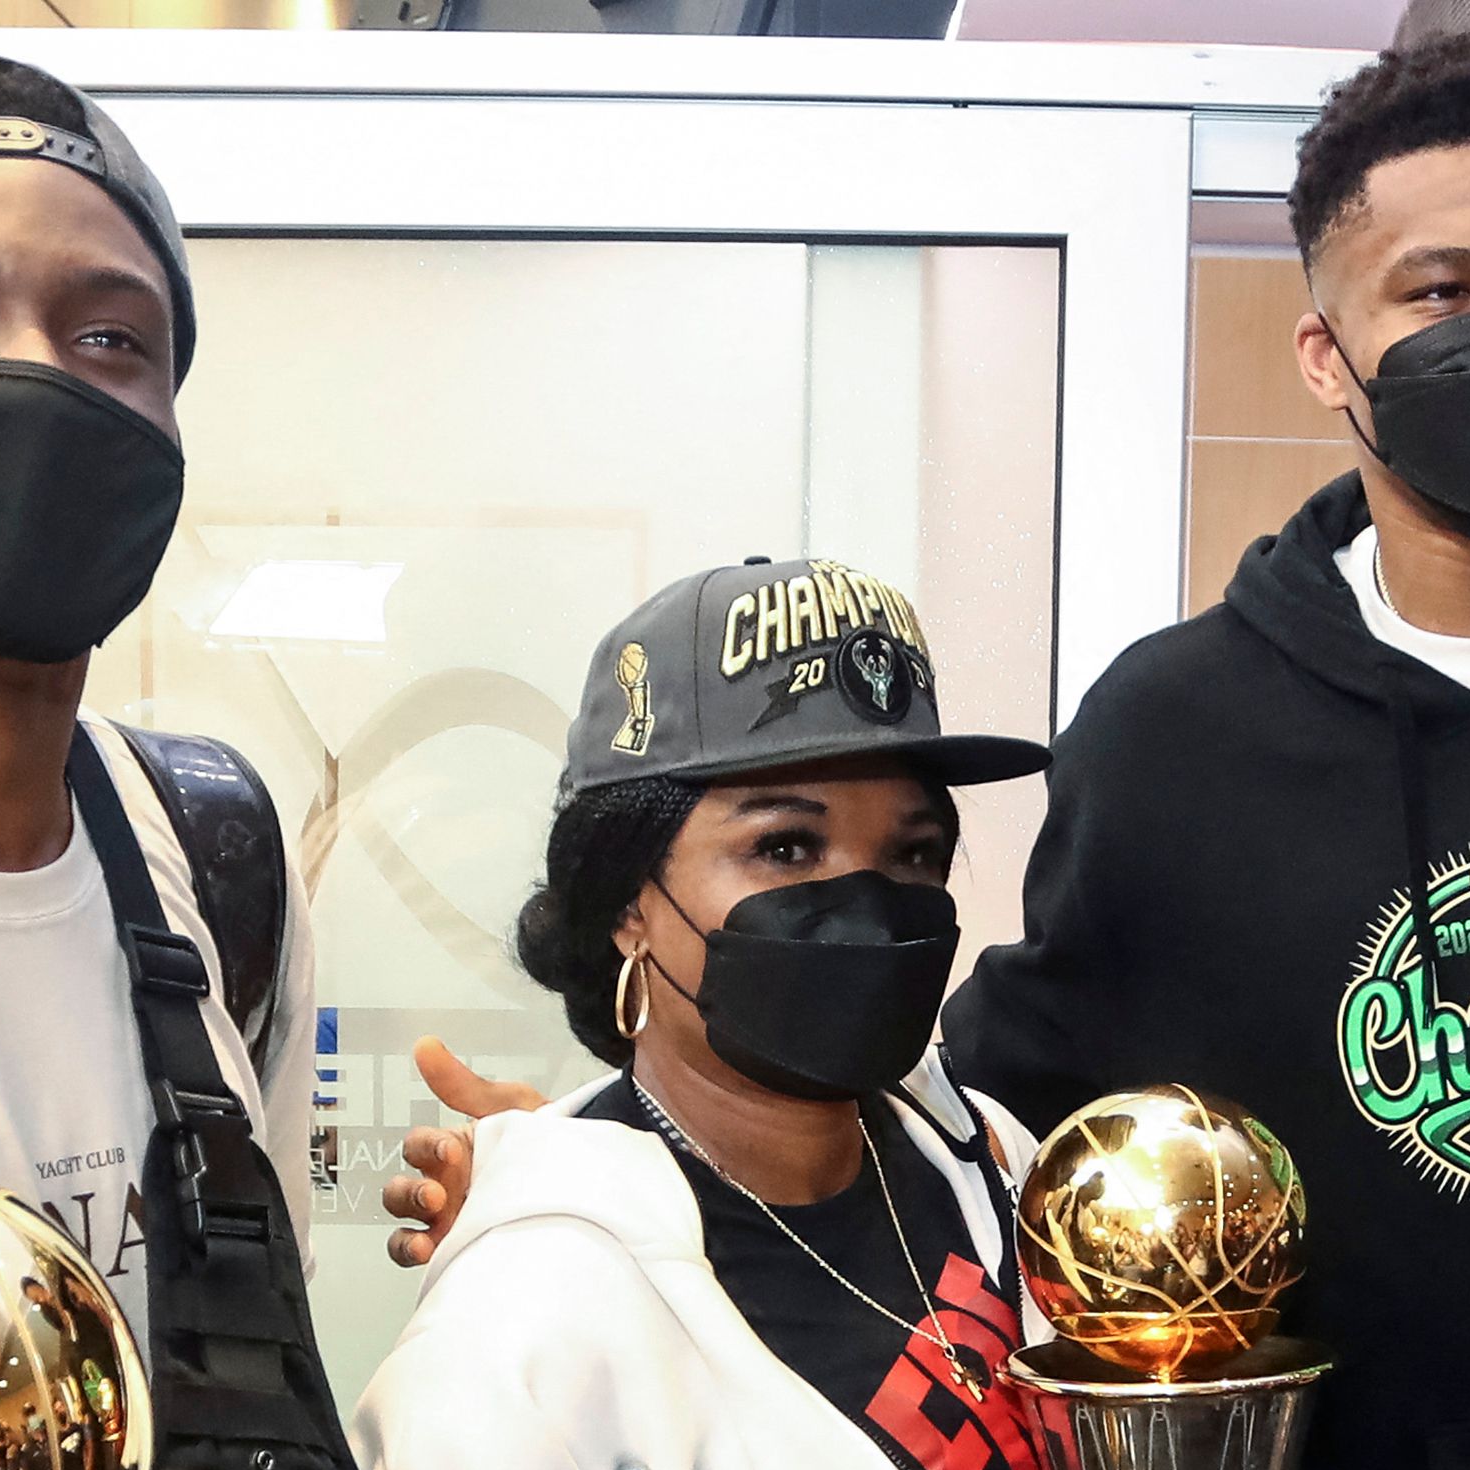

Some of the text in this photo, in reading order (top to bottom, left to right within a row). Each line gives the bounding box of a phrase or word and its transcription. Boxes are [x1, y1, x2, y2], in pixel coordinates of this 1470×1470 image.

[720, 571, 936, 677] CHAMPIO
[787, 656, 826, 694] 20
[35, 1147, 126, 1179] YACHT CLUB
